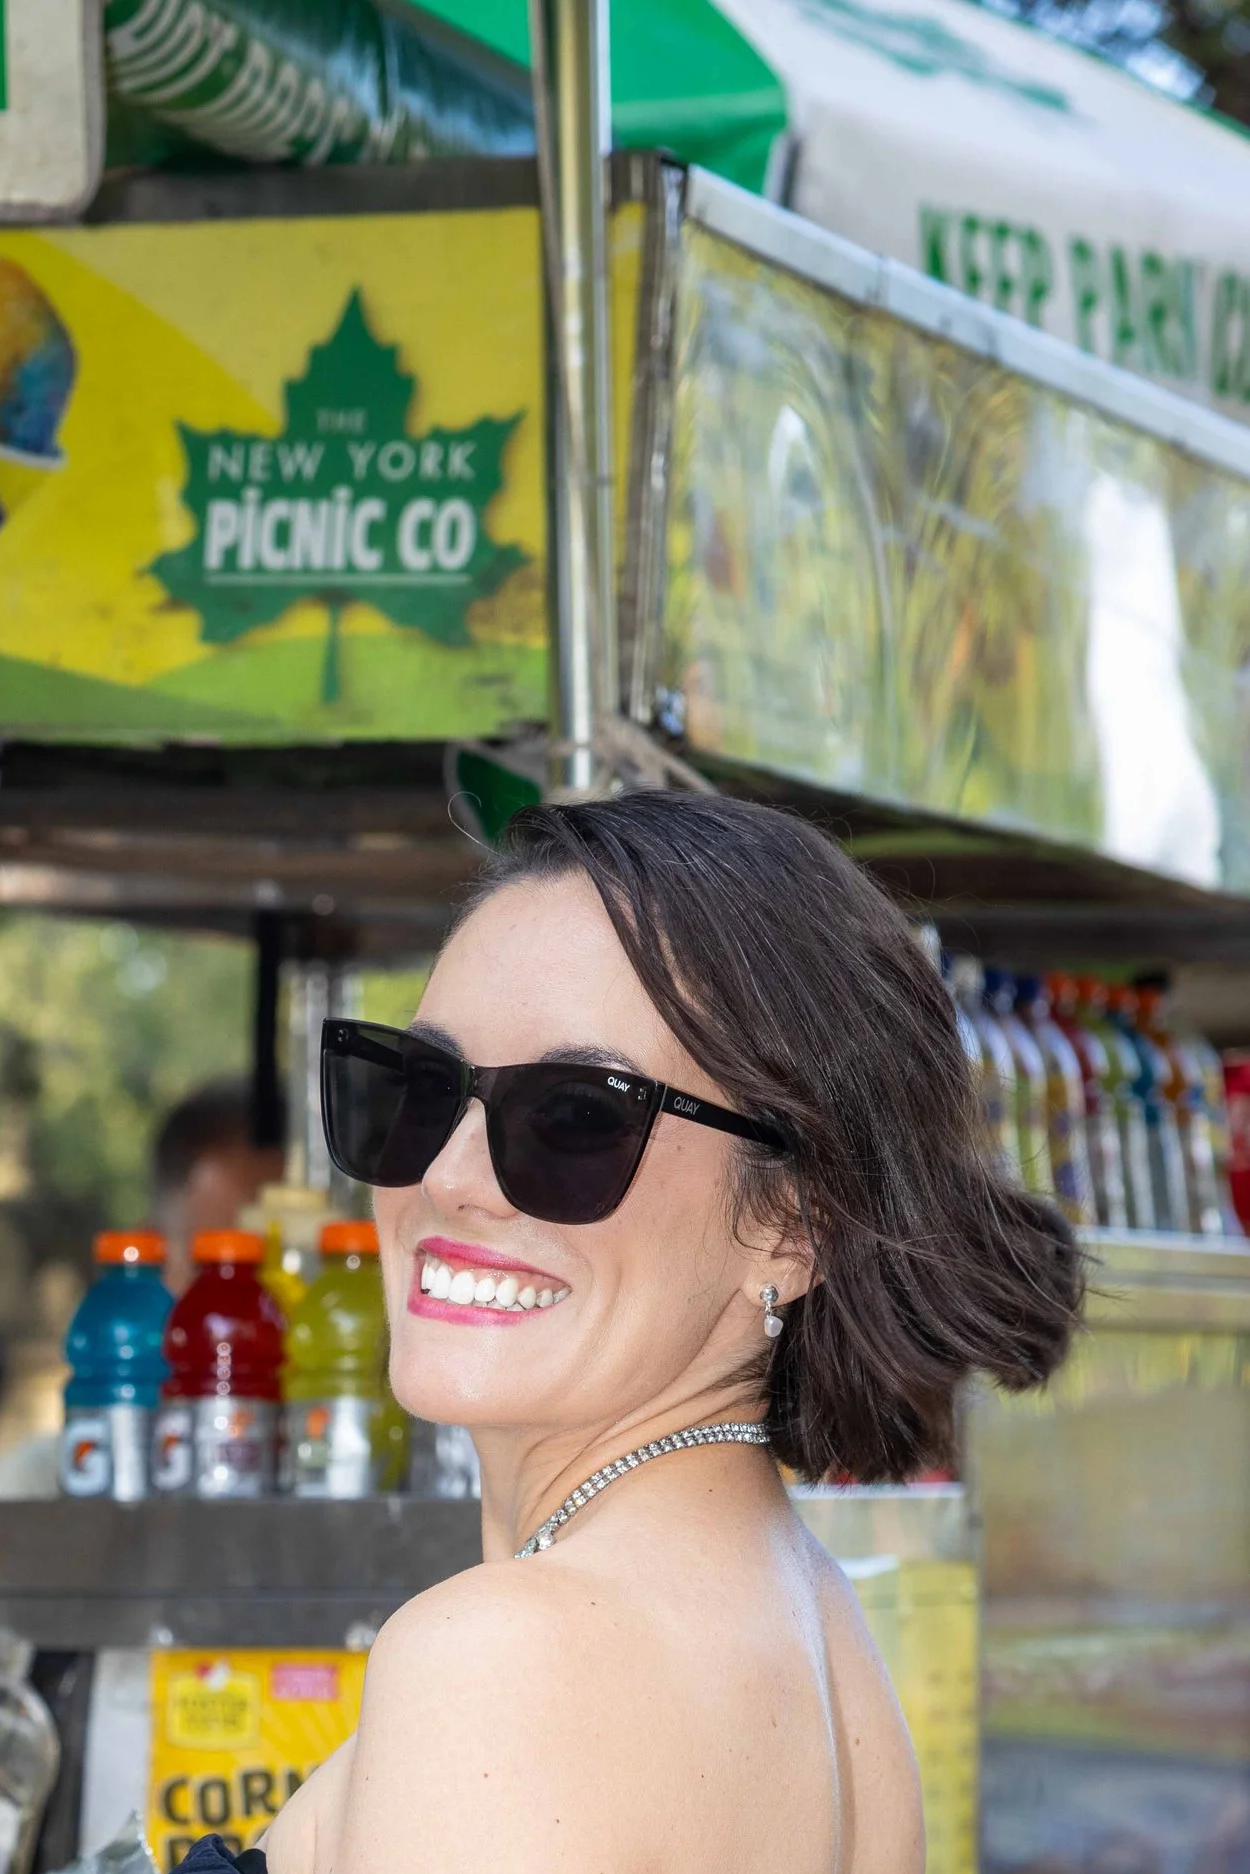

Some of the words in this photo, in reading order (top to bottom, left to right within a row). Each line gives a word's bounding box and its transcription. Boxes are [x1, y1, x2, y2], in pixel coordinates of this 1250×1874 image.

[207, 441, 323, 483] NEW
[347, 440, 477, 482] YORK
[397, 497, 476, 571] CO
[607, 1076, 631, 1093] QUAY
[673, 1096, 700, 1116] QUAY
